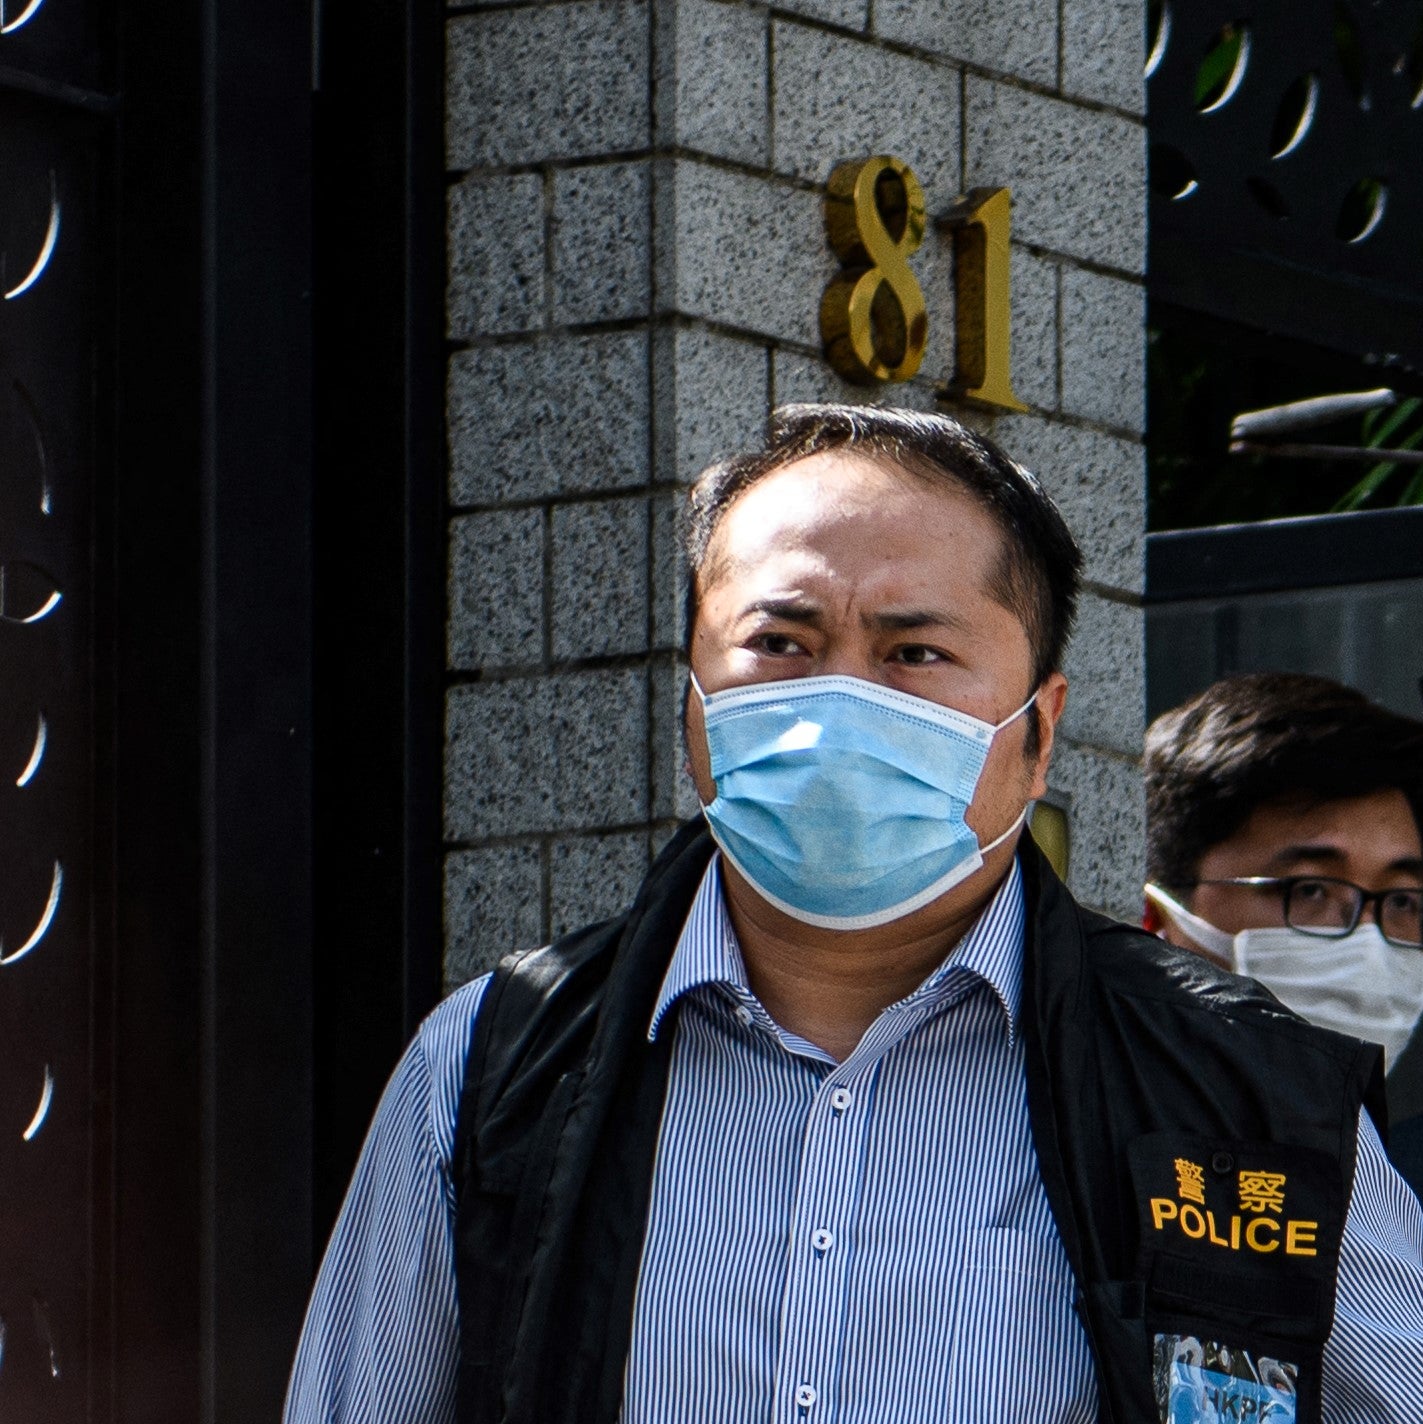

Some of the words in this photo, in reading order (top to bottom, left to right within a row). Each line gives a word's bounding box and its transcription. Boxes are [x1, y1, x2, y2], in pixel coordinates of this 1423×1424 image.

[820, 154, 1029, 413] 81
[1174, 1157, 1286, 1214] 警察
[1150, 1198, 1318, 1256] POLICE
